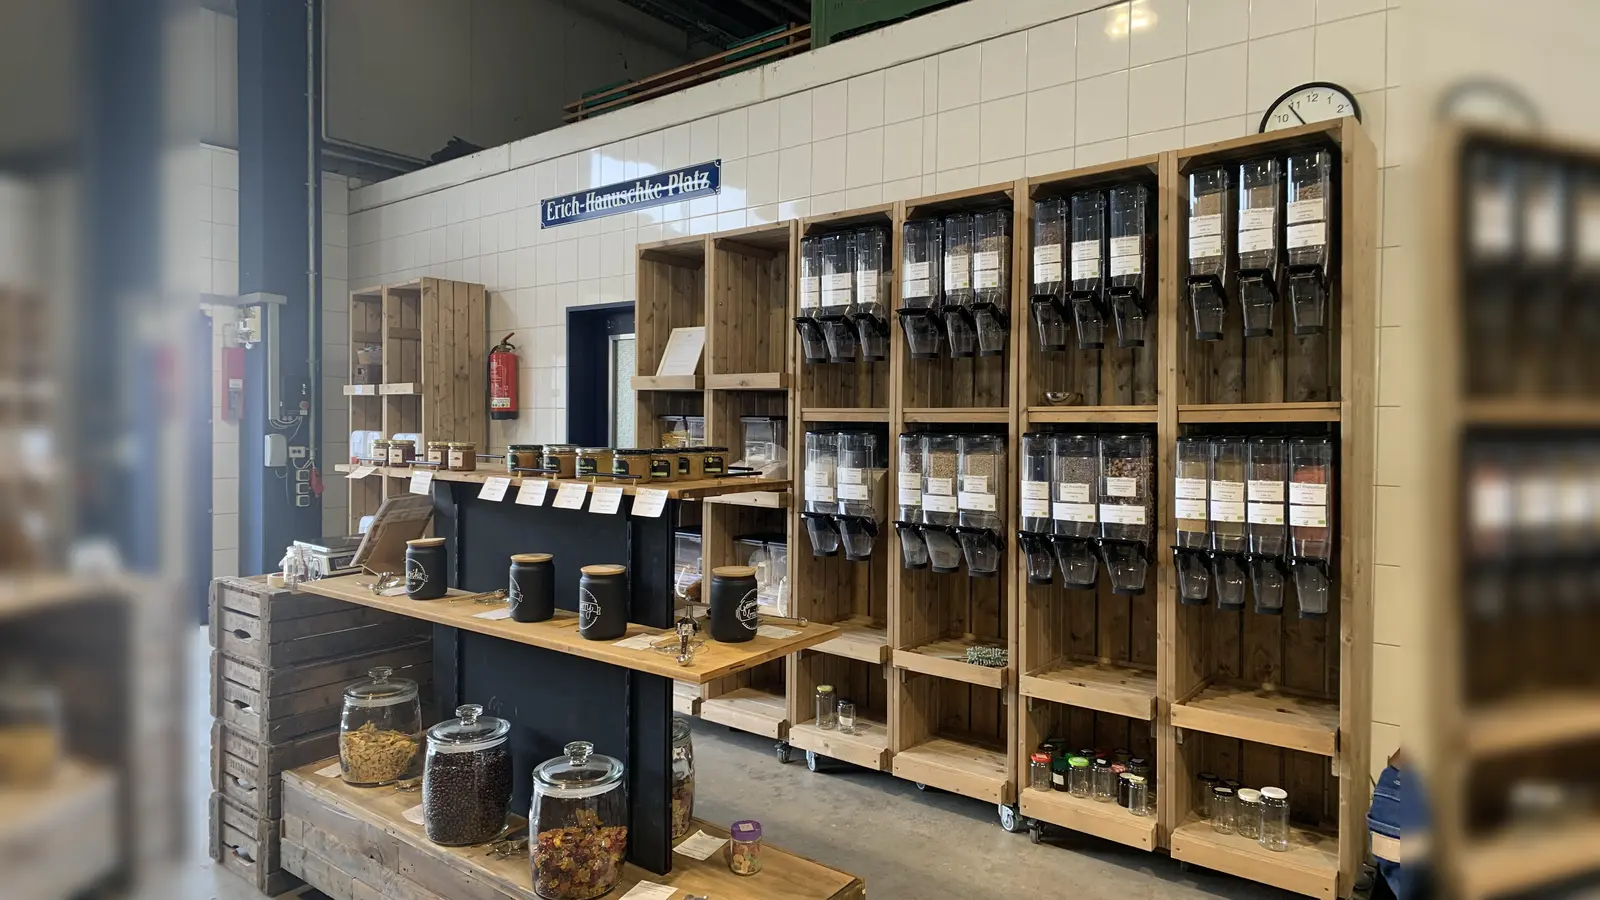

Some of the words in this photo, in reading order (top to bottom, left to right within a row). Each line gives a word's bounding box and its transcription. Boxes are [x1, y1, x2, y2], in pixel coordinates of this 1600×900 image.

[1306, 93, 1319, 103] 12
[1327, 96, 1332, 104] 1
[1291, 101, 1301, 109] 11
[1336, 104, 1344, 113] 2
[1277, 113, 1289, 123] 10
